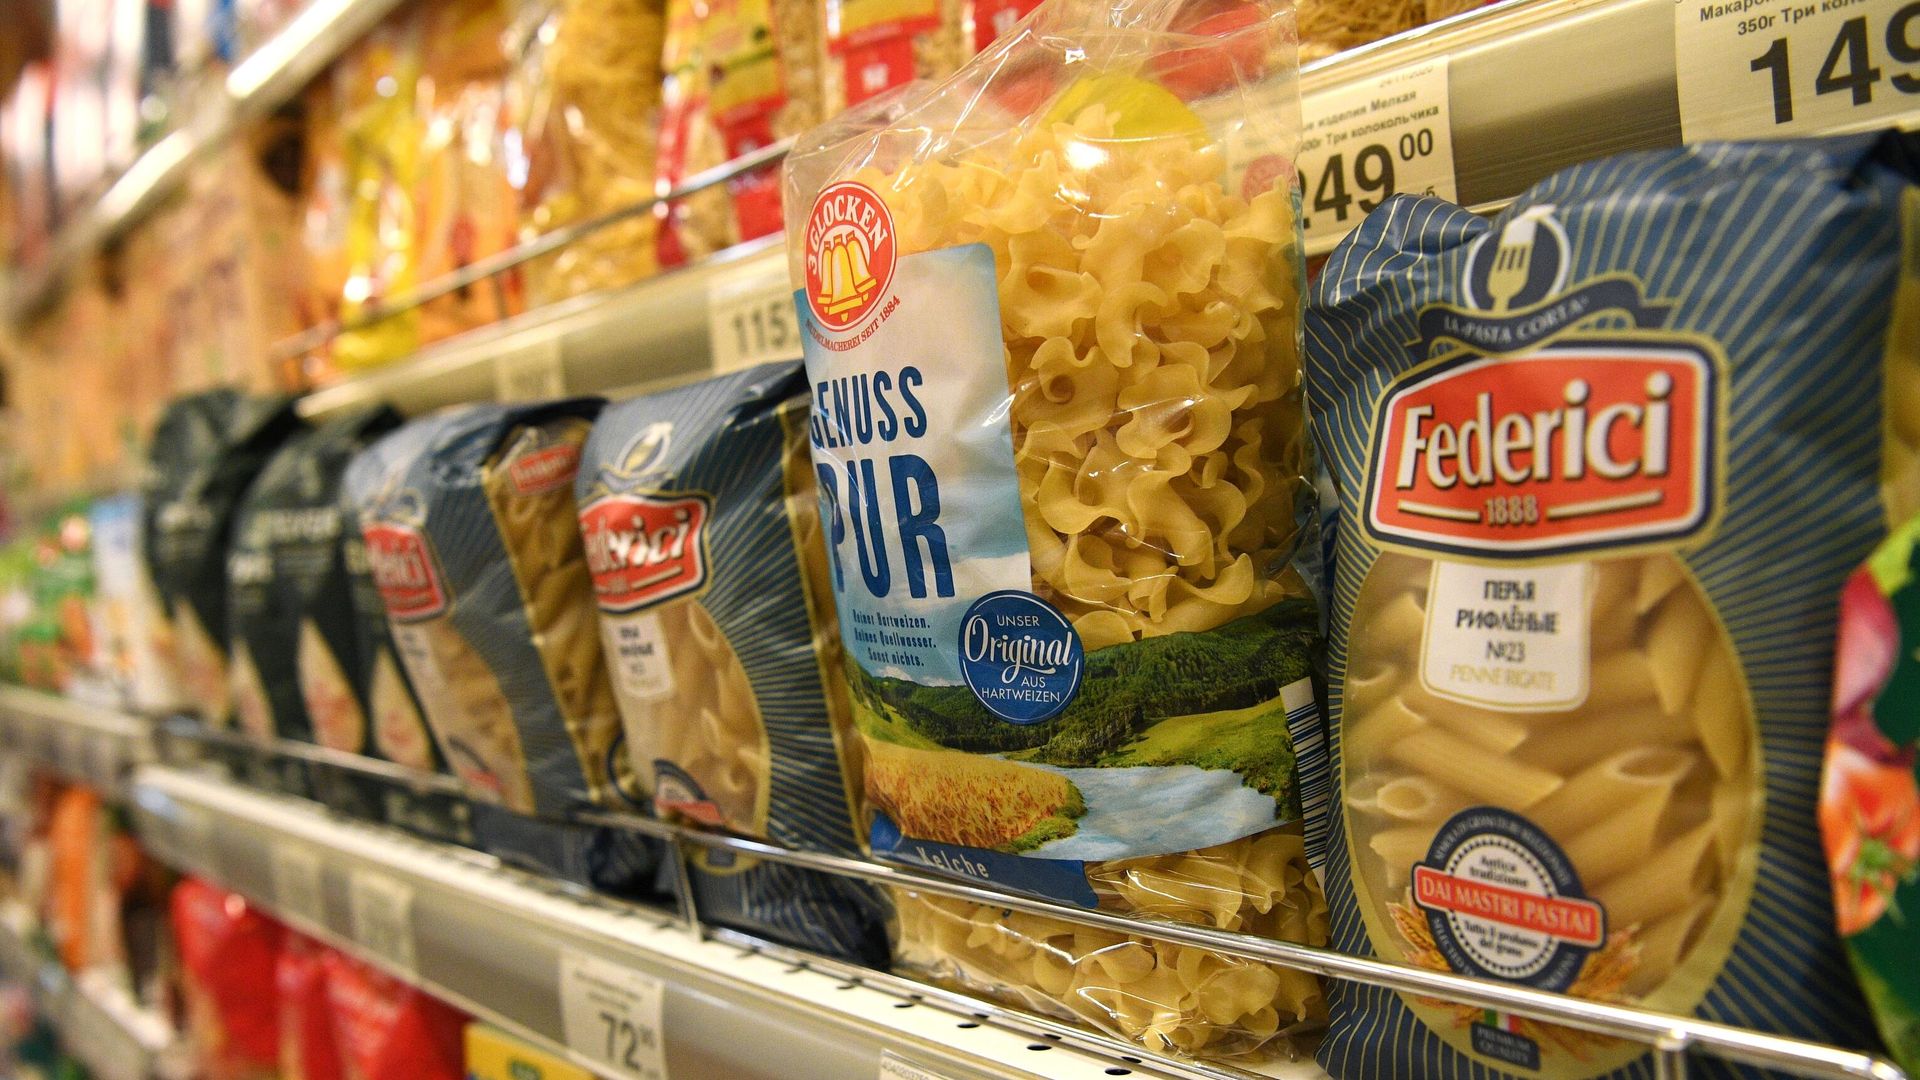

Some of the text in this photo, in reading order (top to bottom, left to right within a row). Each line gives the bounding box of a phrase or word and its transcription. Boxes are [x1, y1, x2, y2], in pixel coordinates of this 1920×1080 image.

[1700, 0, 1775, 21] Макаро
[1738, 15, 1776, 35] 350г
[1781, 4, 1815, 24] Три
[1750, 2, 1920, 125] 149
[1371, 91, 1417, 112] Мелкая
[1325, 130, 1348, 146] Три
[1351, 106, 1440, 138] колокольчика
[1400, 128, 1433, 162] 00
[807, 194, 888, 275] 3 GLOCKEN
[861, 318, 880, 342] SEIT
[879, 295, 900, 323] 1884
[1443, 301, 1582, 344] LA PASTA CORTA
[811, 366, 928, 450] GENUSS
[1395, 371, 1672, 490] Federici
[1485, 494, 1539, 525] 1888
[816, 454, 955, 599] PUR
[1484, 580, 1535, 600] ПЕРЬЯ
[876, 611, 931, 629] Hartweizen.
[997, 615, 1040, 627] UNSER
[1456, 604, 1559, 634] РИФЛЁНЫЕ
[880, 630, 937, 648] Quellwasser.
[964, 614, 1073, 684] Original
[1486, 641, 1526, 663] №23
[891, 652, 925, 667] nichts.
[1021, 676, 1046, 688] AUS
[1450, 663, 1556, 692] PENNE RIGATE
[981, 687, 1061, 703] HARTWEIZEN
[916, 845, 989, 879] Kelche
[1422, 876, 1592, 935] DAI MASTRI PASTAI
